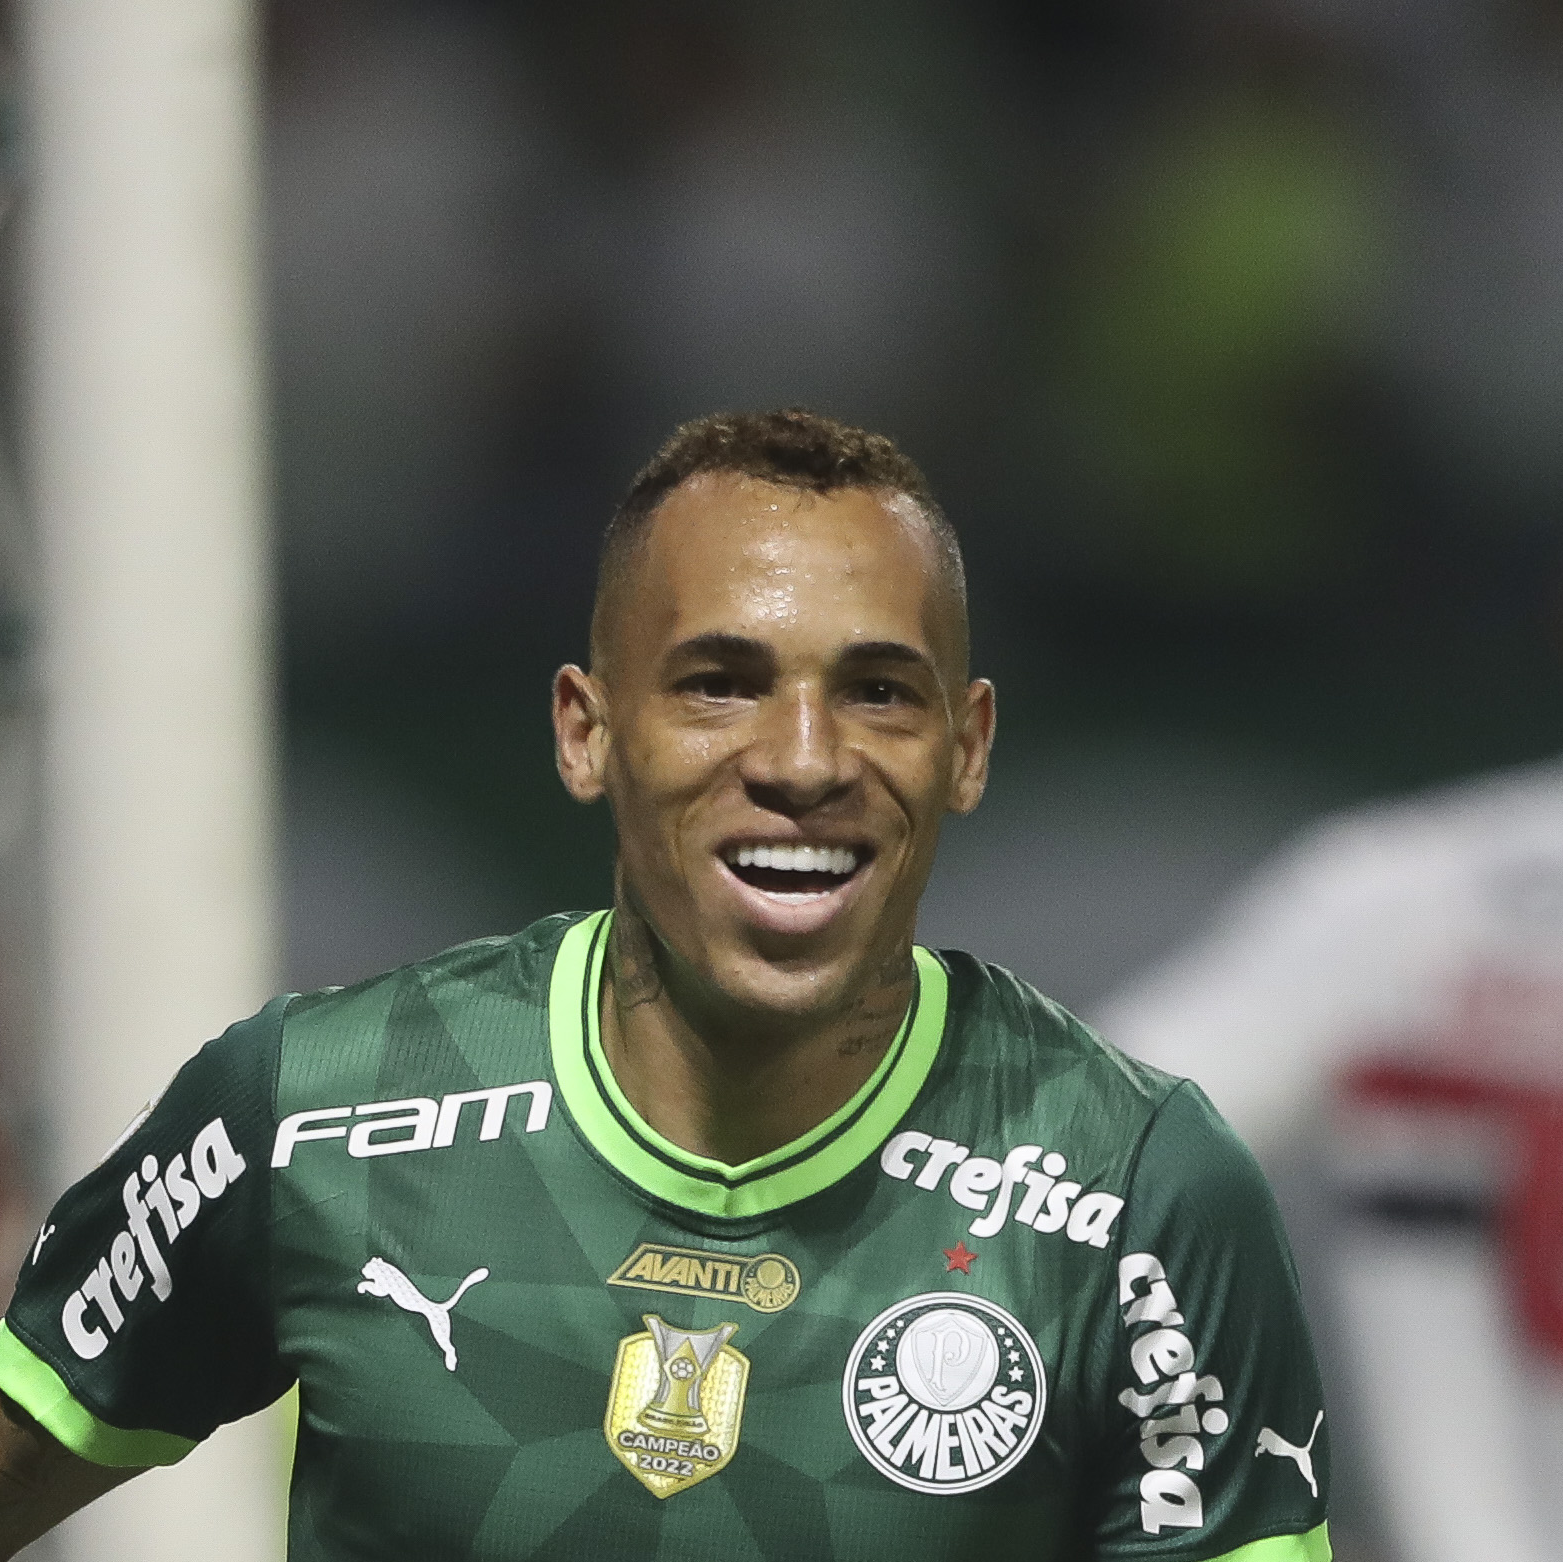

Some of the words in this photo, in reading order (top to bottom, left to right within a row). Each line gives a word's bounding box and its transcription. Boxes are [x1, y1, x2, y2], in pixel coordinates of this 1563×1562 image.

[62, 1117, 247, 1360] crefisa
[880, 1129, 1125, 1249] crefisa
[625, 1253, 741, 1293] AVANTI
[618, 1431, 720, 1462] CAMPEÃO
[858, 1375, 1033, 1481] PALMEIRAS
[1118, 1252, 1229, 1535] crefisa
[639, 1454, 694, 1477] 2022
